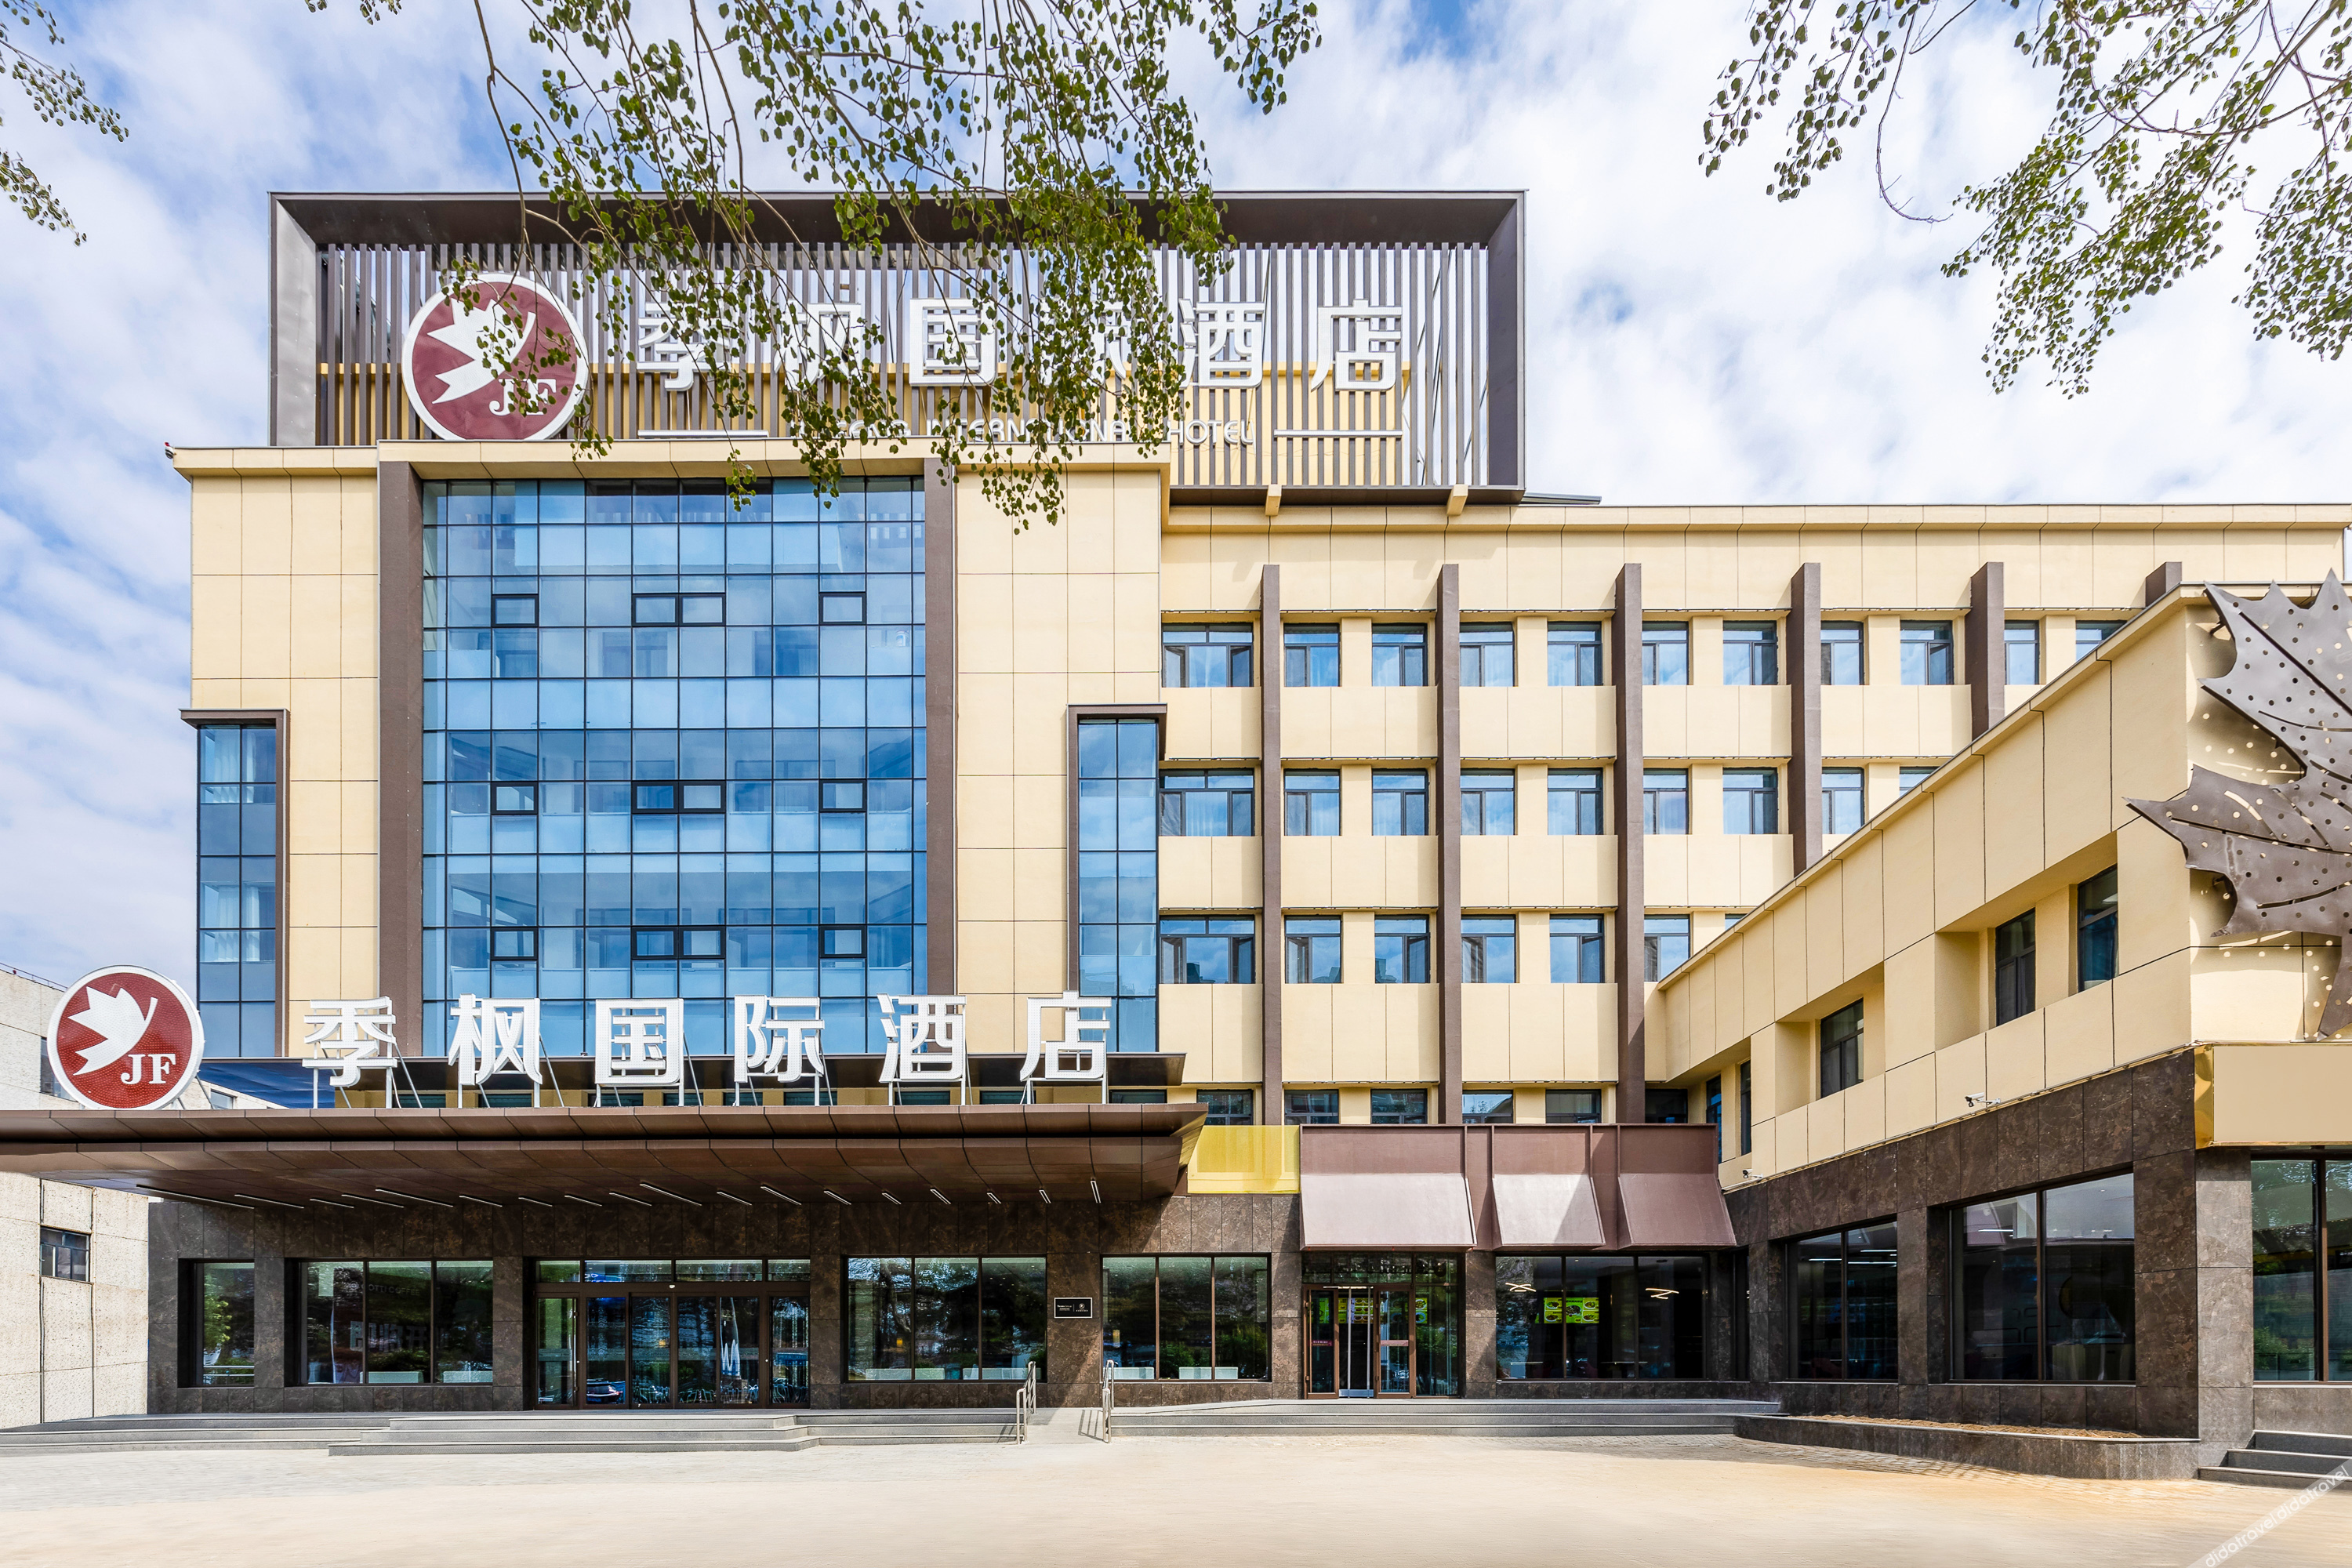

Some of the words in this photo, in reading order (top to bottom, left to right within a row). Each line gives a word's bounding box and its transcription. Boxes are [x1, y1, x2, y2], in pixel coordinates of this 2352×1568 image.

[488, 378, 557, 416] JF
[1165, 419, 1253, 446] HOTEL
[301, 989, 1112, 1088] 季枫国际酒店
[120, 1053, 176, 1085] JF
